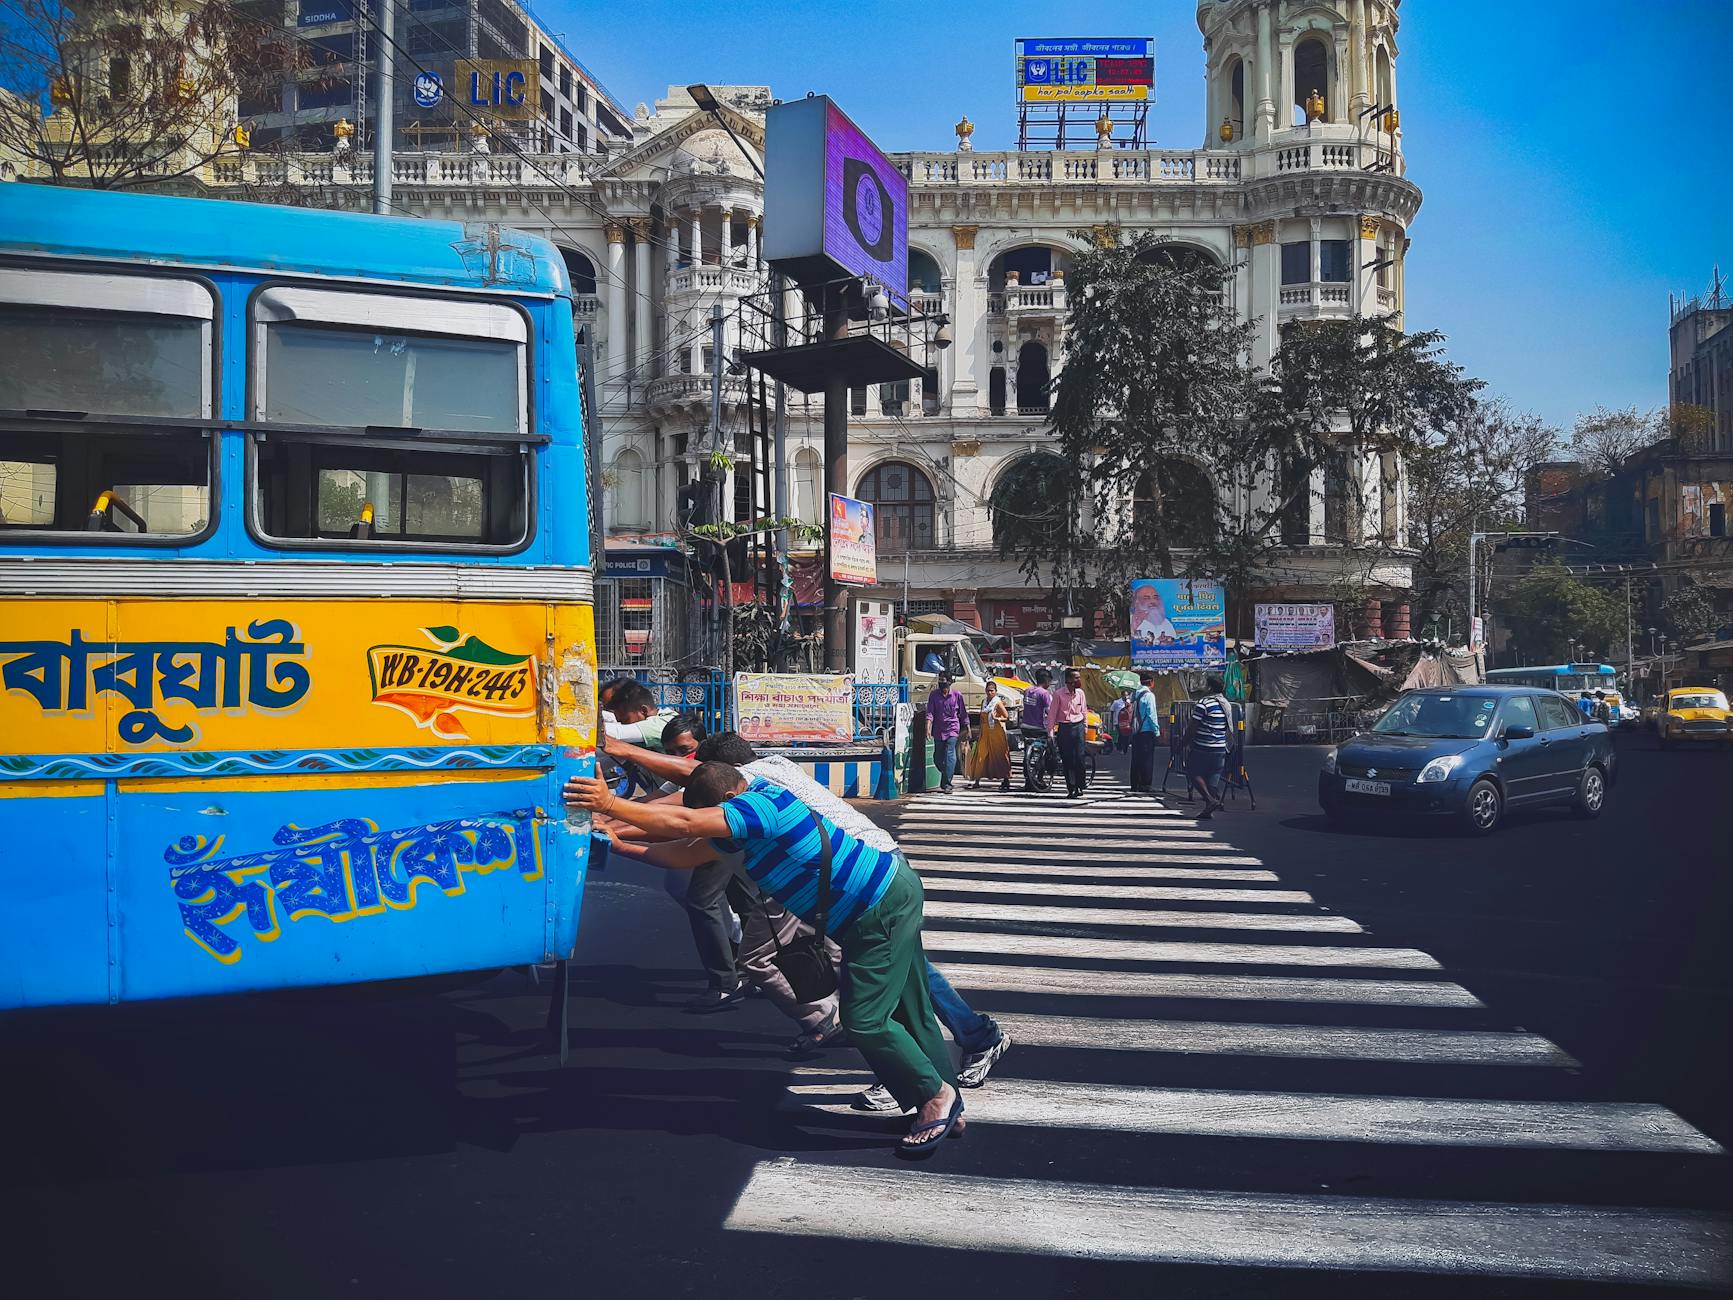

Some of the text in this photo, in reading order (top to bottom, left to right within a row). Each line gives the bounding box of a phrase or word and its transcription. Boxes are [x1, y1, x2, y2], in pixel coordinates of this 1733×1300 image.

[305, 12, 337, 23] SIDDHA
[1055, 61, 1088, 83] LIC
[470, 71, 526, 107] LIC
[0, 618, 311, 744] বাবুঘাট
